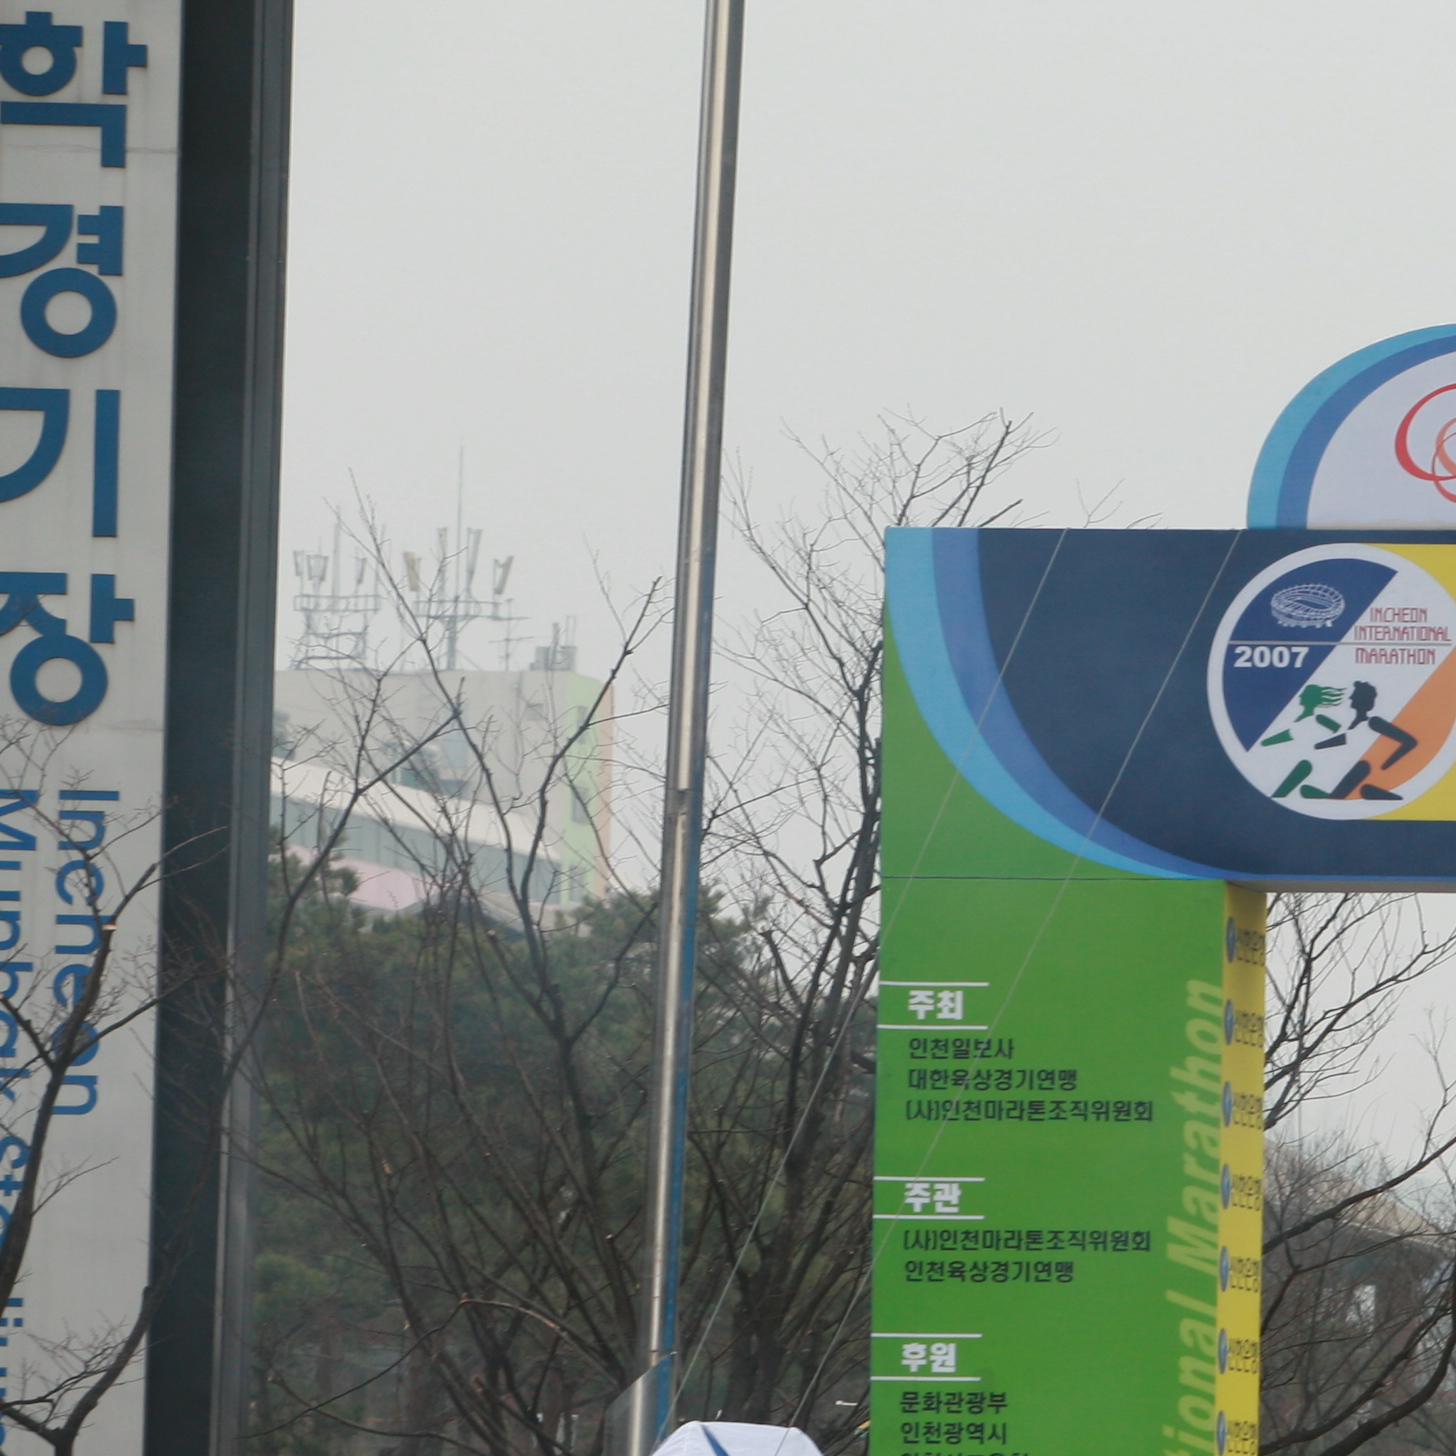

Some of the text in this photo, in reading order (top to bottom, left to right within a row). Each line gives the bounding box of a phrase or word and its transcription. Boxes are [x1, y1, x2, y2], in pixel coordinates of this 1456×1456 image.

[1370, 608, 1427, 623] INCHEON
[1354, 626, 1452, 641] INTERNATIONAL
[1233, 646, 1310, 668] 2007
[1356, 649, 1435, 664] MARATHON
[907, 989, 964, 1020] 주최
[908, 1037, 1014, 1060] 인천일보사
[908, 1068, 1078, 1091] 대한육상경기연맹
[905, 1099, 1153, 1122] (사)인천마라톤조직위원회
[904, 1182, 961, 1213] 주관
[903, 1229, 1151, 1252] (사)인천마라톤조직위원회
[904, 1259, 1074, 1283] 인천육상경기연맹
[901, 1341, 957, 1373] 후원
[899, 1390, 1008, 1415] 문화관광부
[900, 1420, 1007, 1446] 인천광역시
